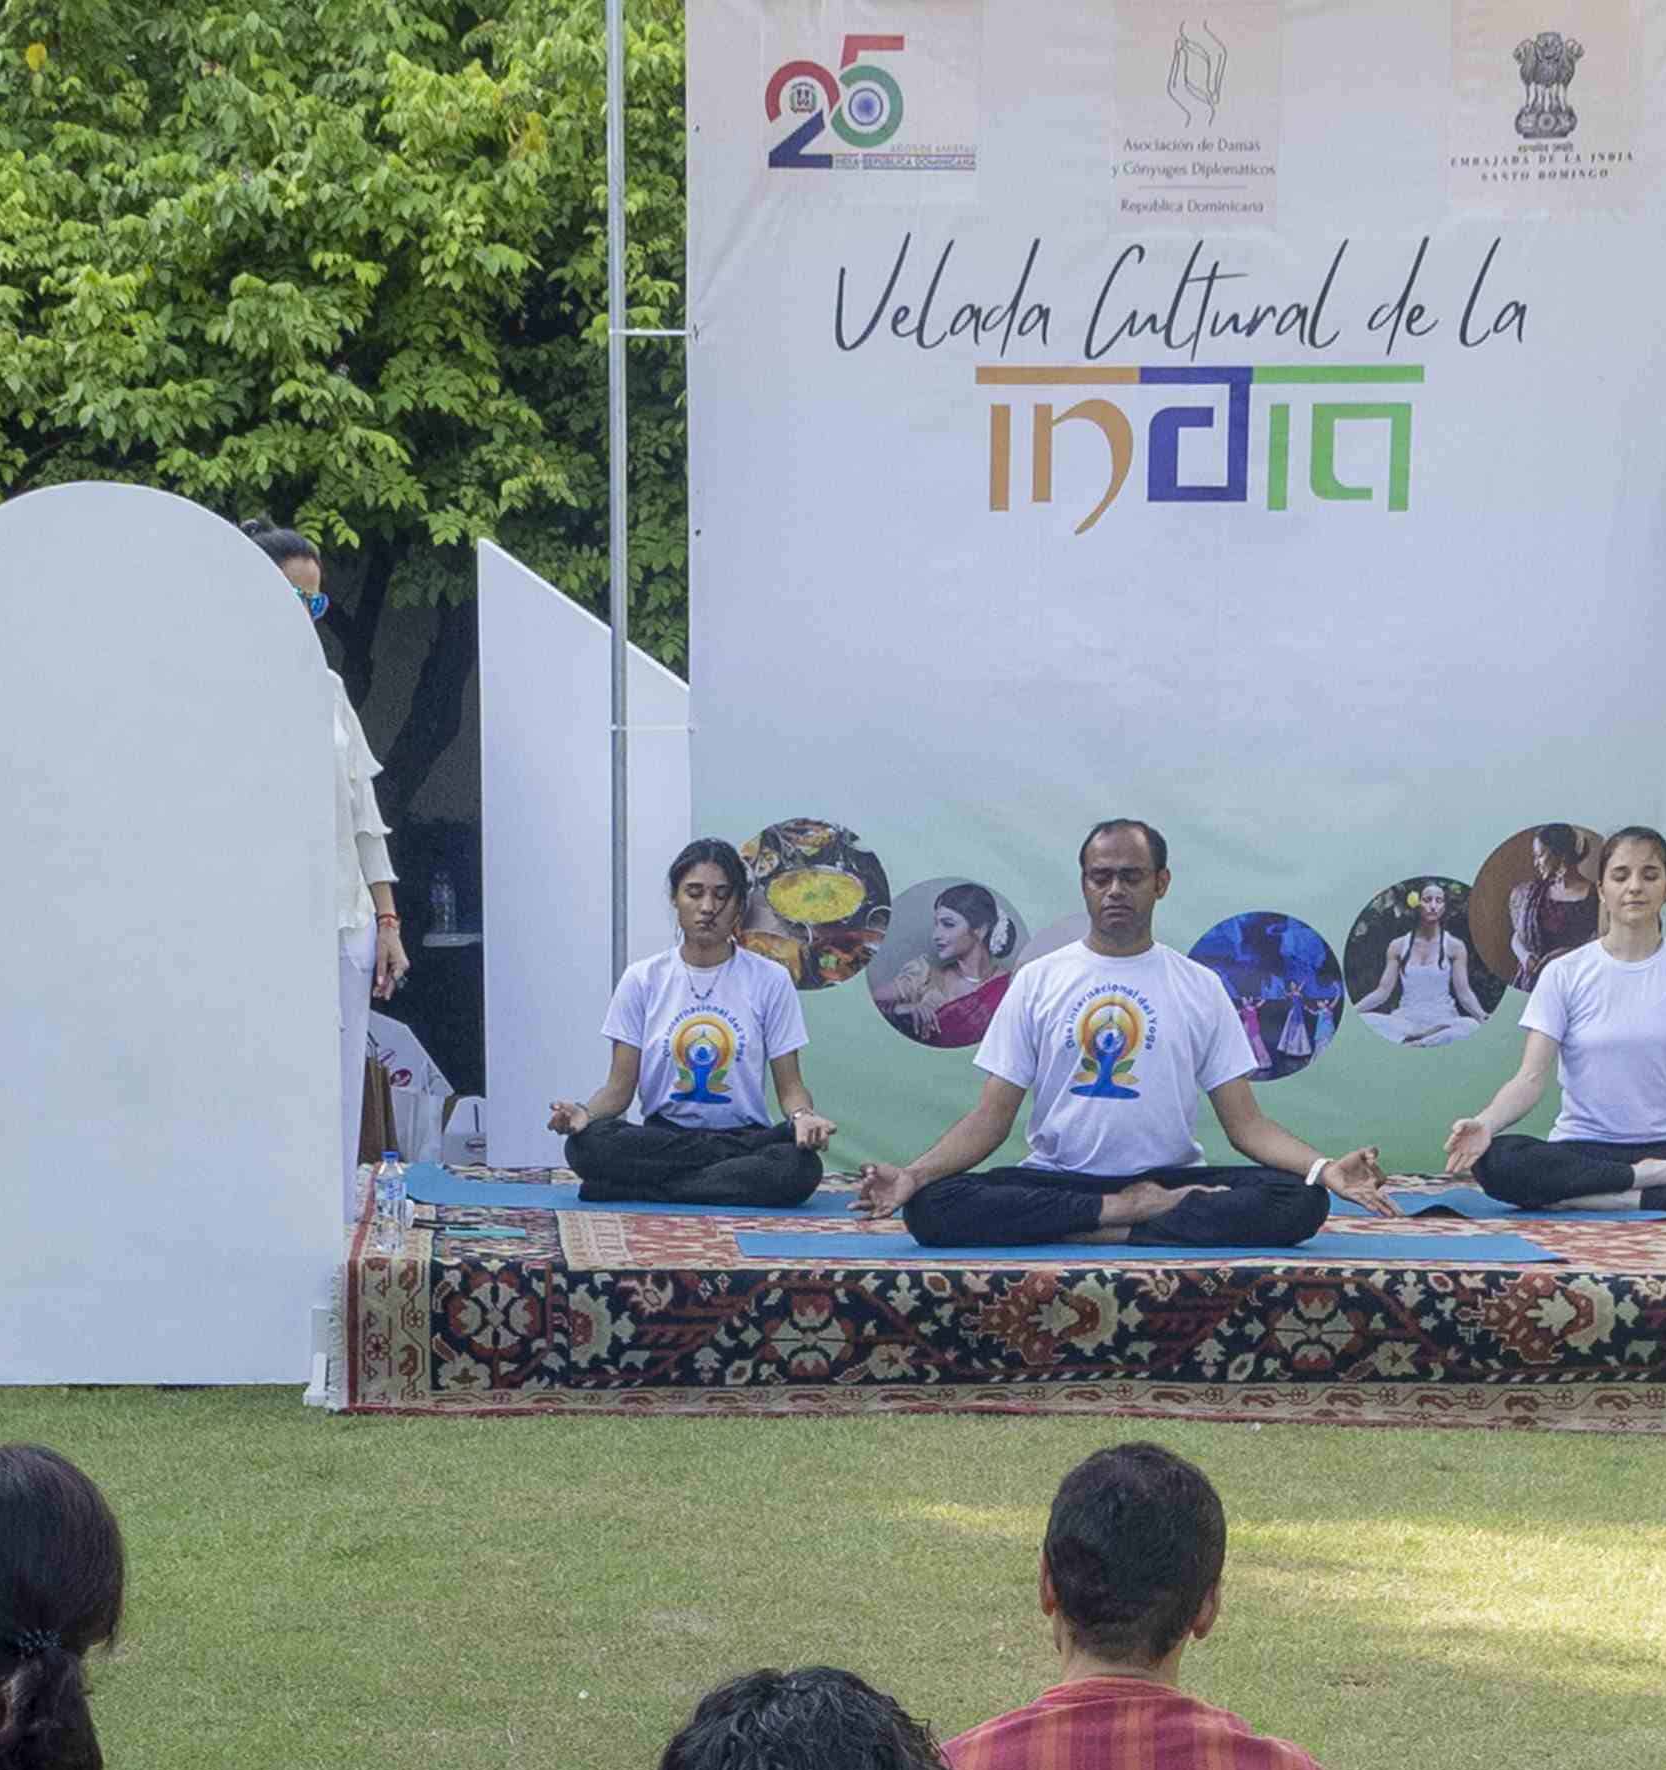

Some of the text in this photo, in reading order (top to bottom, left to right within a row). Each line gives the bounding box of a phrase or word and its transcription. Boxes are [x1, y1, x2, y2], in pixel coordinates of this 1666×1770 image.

[765, 35, 904, 168] 25
[1197, 138, 1213, 151] de
[1217, 138, 1261, 151] Damas
[1450, 152, 1633, 167] EMBAJADA DE LA INDIA
[1111, 166, 1119, 178] y
[1481, 169, 1609, 182] SANTO DOMINGO
[1187, 199, 1263, 213] Dominicana
[835, 231, 1528, 362] Velada Cultural de la
[1144, 1017, 1158, 1051] Yoga
